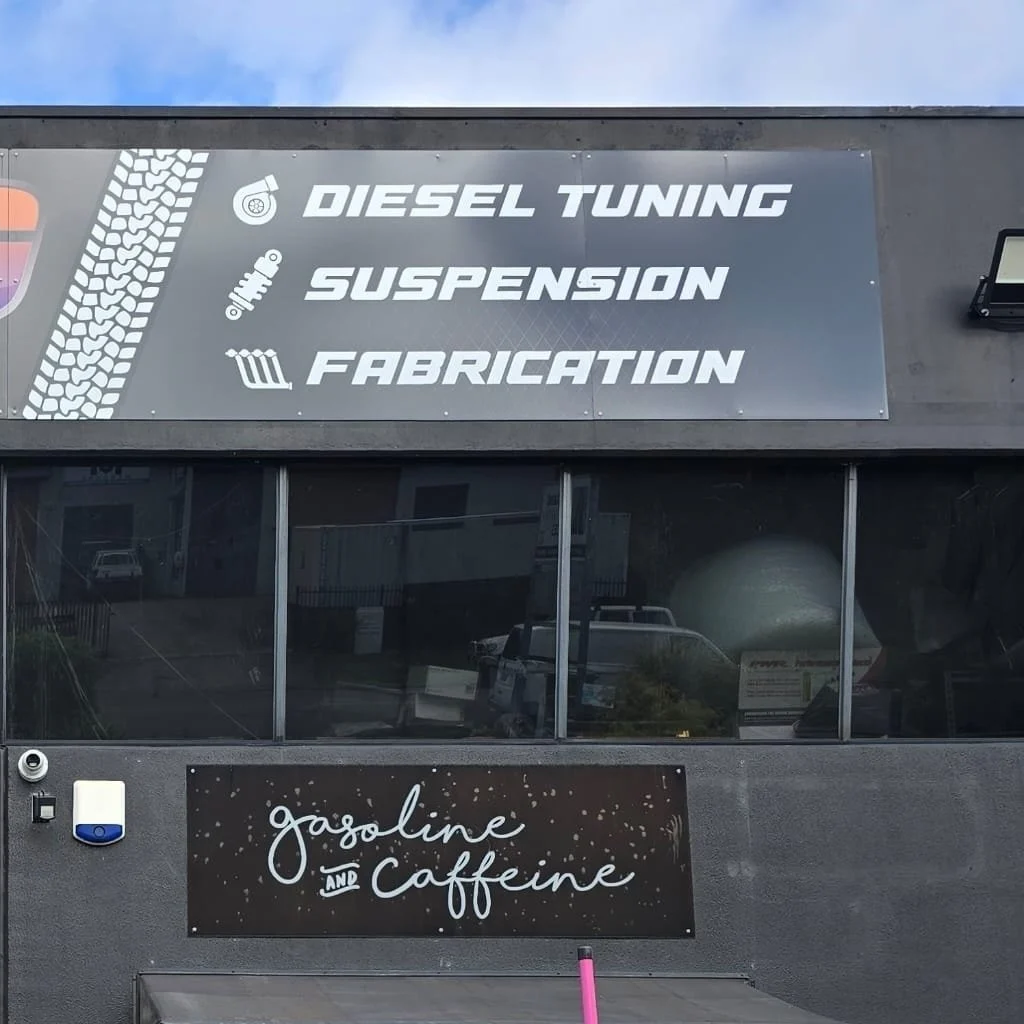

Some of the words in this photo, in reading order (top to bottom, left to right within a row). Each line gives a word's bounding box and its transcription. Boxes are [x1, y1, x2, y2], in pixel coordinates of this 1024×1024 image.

[302, 184, 536, 217] DIESEL
[557, 184, 793, 217] TUNING
[304, 266, 730, 301] SUSPENSION
[306, 349, 746, 385] FABRICATION
[267, 784, 525, 885] gasoline
[323, 866, 359, 894] AND
